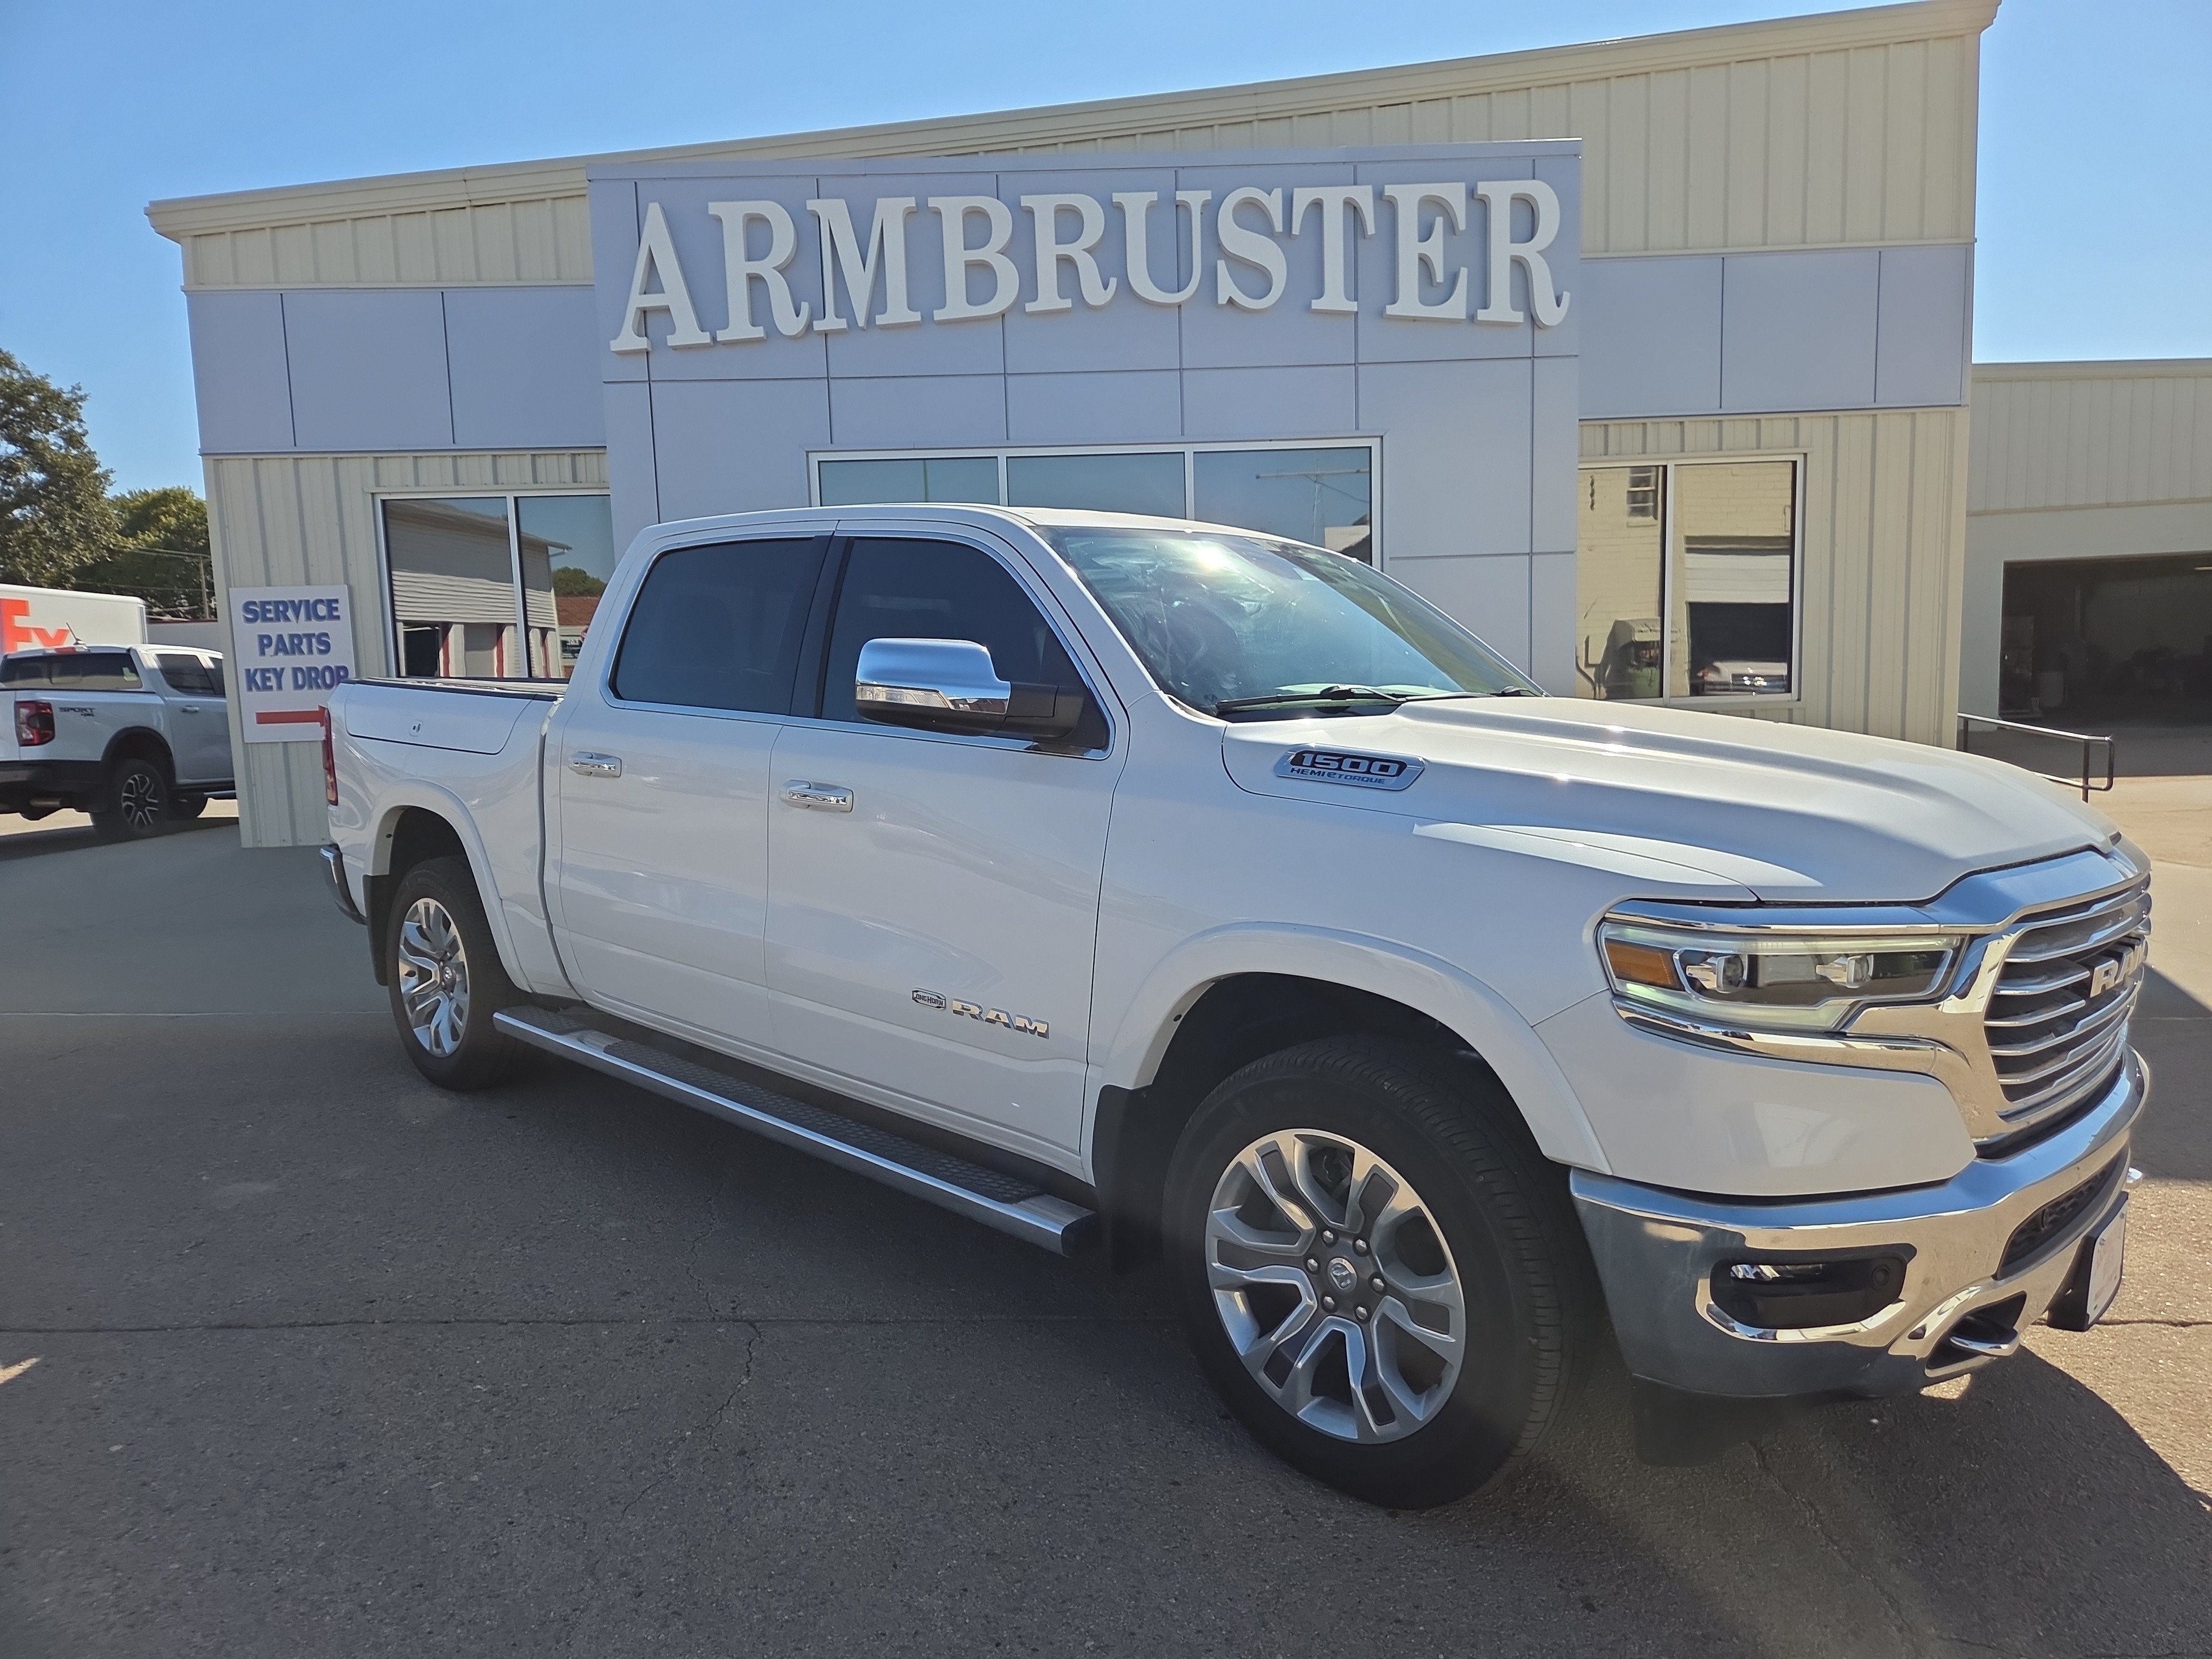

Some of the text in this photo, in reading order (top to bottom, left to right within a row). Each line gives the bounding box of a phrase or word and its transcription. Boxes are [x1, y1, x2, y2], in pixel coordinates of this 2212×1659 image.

[609, 180, 1571, 354] ARMBRUSTER
[242, 598, 340, 624] SERVICE
[257, 632, 331, 657] PARTS
[245, 665, 349, 692] KEY DROP
[1290, 767, 1325, 777] HEMI
[1302, 753, 1400, 776] 1500
[953, 998, 1049, 1039] RAM
